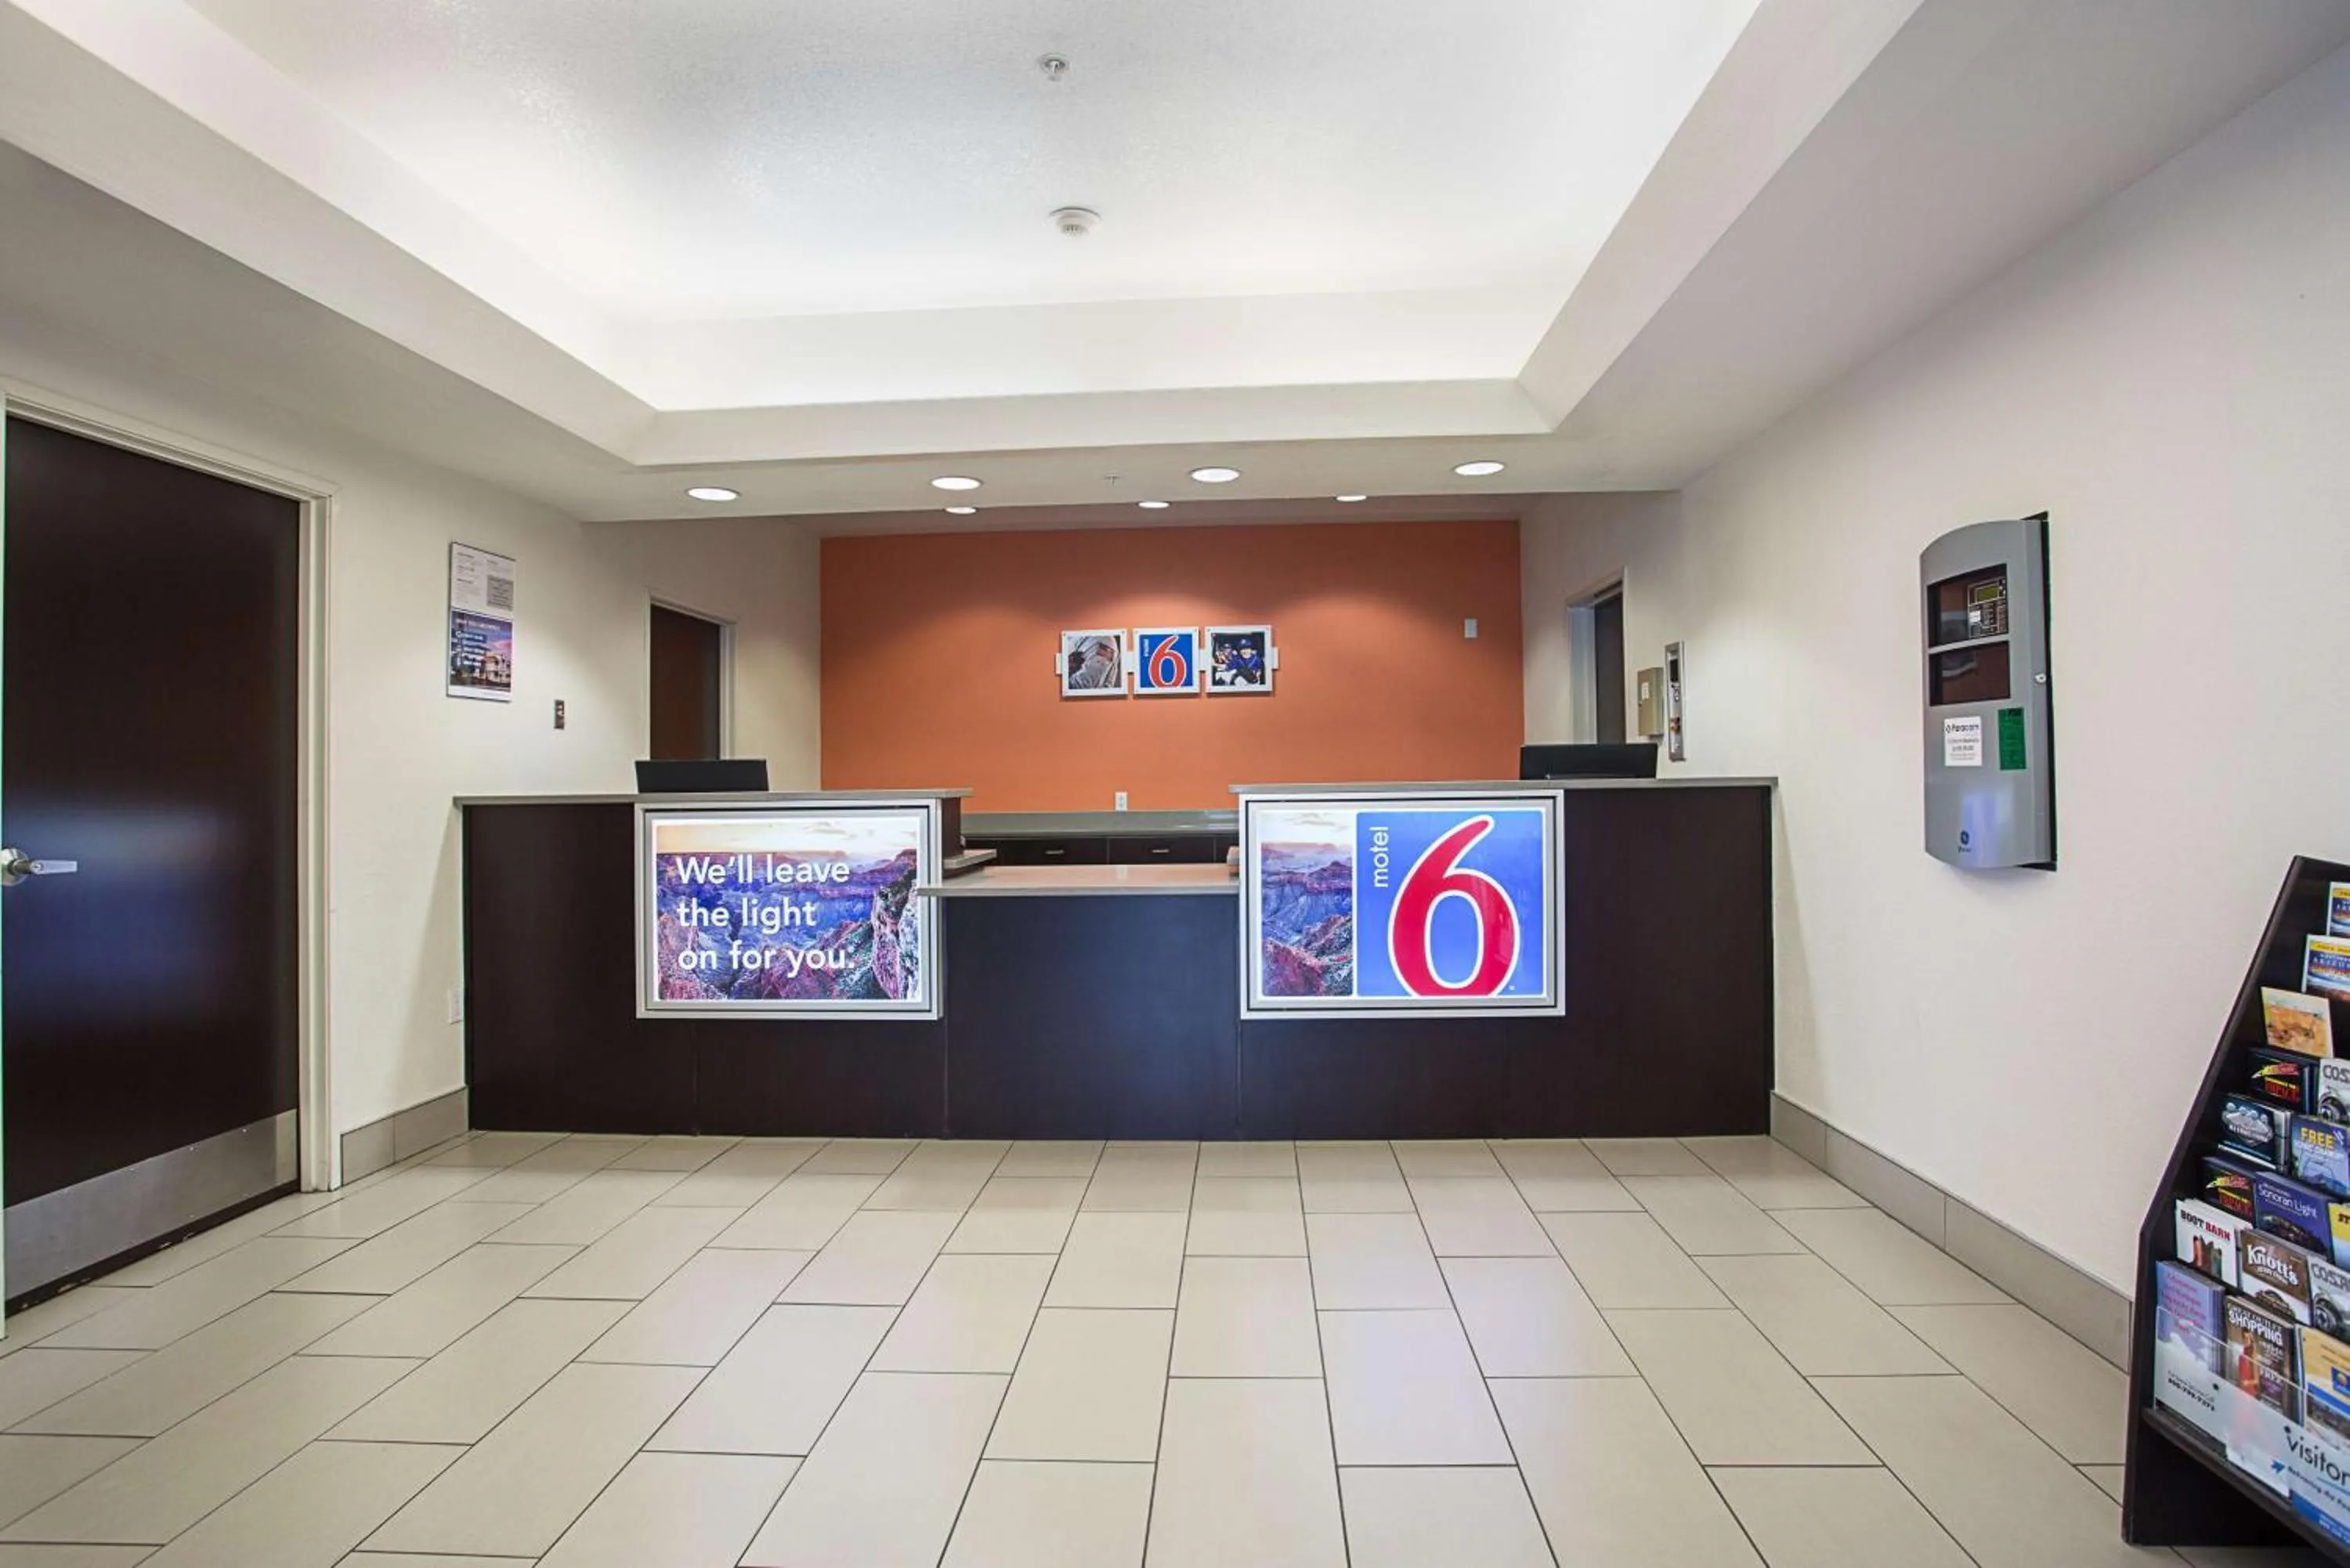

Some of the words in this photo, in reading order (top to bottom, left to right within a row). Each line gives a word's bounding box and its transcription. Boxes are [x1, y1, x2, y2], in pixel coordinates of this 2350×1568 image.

[1148, 634, 1187, 689] 6
[675, 854, 753, 884] We'll
[766, 854, 850, 884] leave
[1369, 826, 1390, 887] motel
[677, 898, 730, 927] the
[742, 897, 818, 935] light
[1387, 815, 1521, 996] 6
[678, 949, 718, 971] on
[728, 940, 779, 970] for
[786, 948, 855, 978] you.
[2301, 1127, 2335, 1151] FREE
[2180, 1209, 2205, 1230] BOOT
[2205, 1221, 2231, 1241] BARN
[2246, 1243, 2299, 1286] Knott's
[2229, 1308, 2283, 1346] SHOPPING
